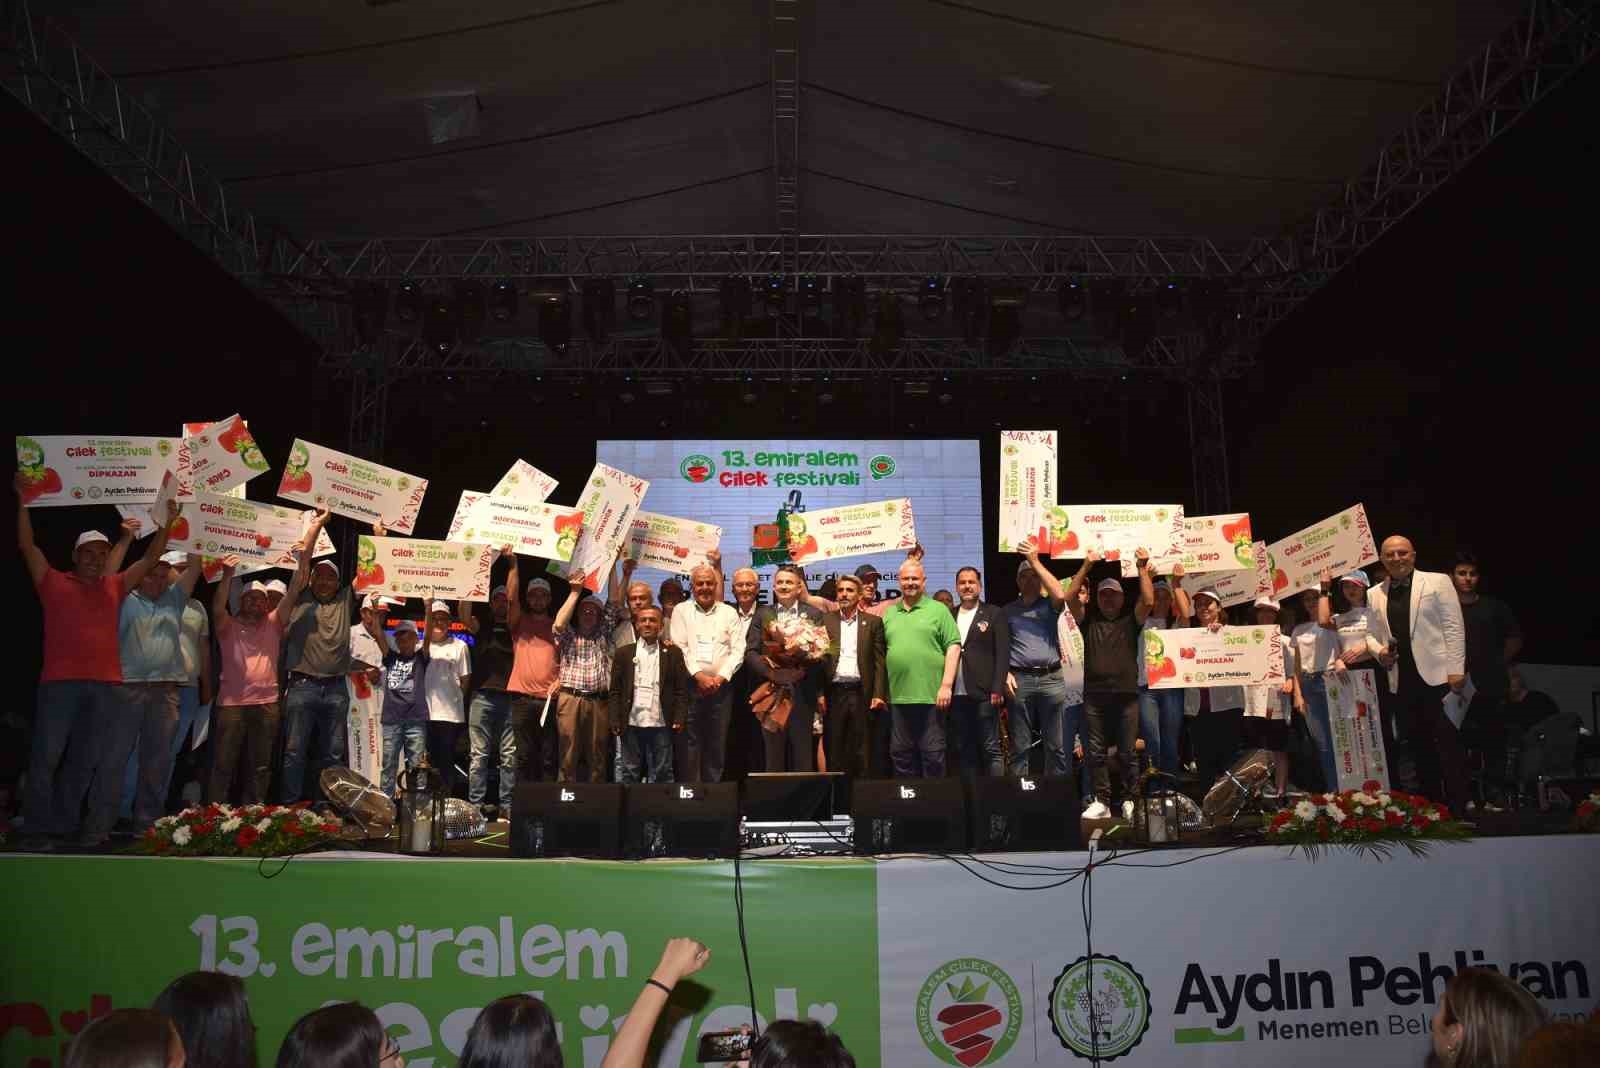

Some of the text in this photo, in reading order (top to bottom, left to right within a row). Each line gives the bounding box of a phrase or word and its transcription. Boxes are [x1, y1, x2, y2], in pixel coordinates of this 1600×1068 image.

[66, 446, 152, 458] Çilek festivali
[721, 450, 859, 467] 13. emiralem
[719, 471, 861, 488] Çilek festivali
[188, 914, 629, 980] 13. emiralem
[1174, 949, 1590, 1029] Aydın Pehan
[1259, 1017, 1380, 1041] Menemen
